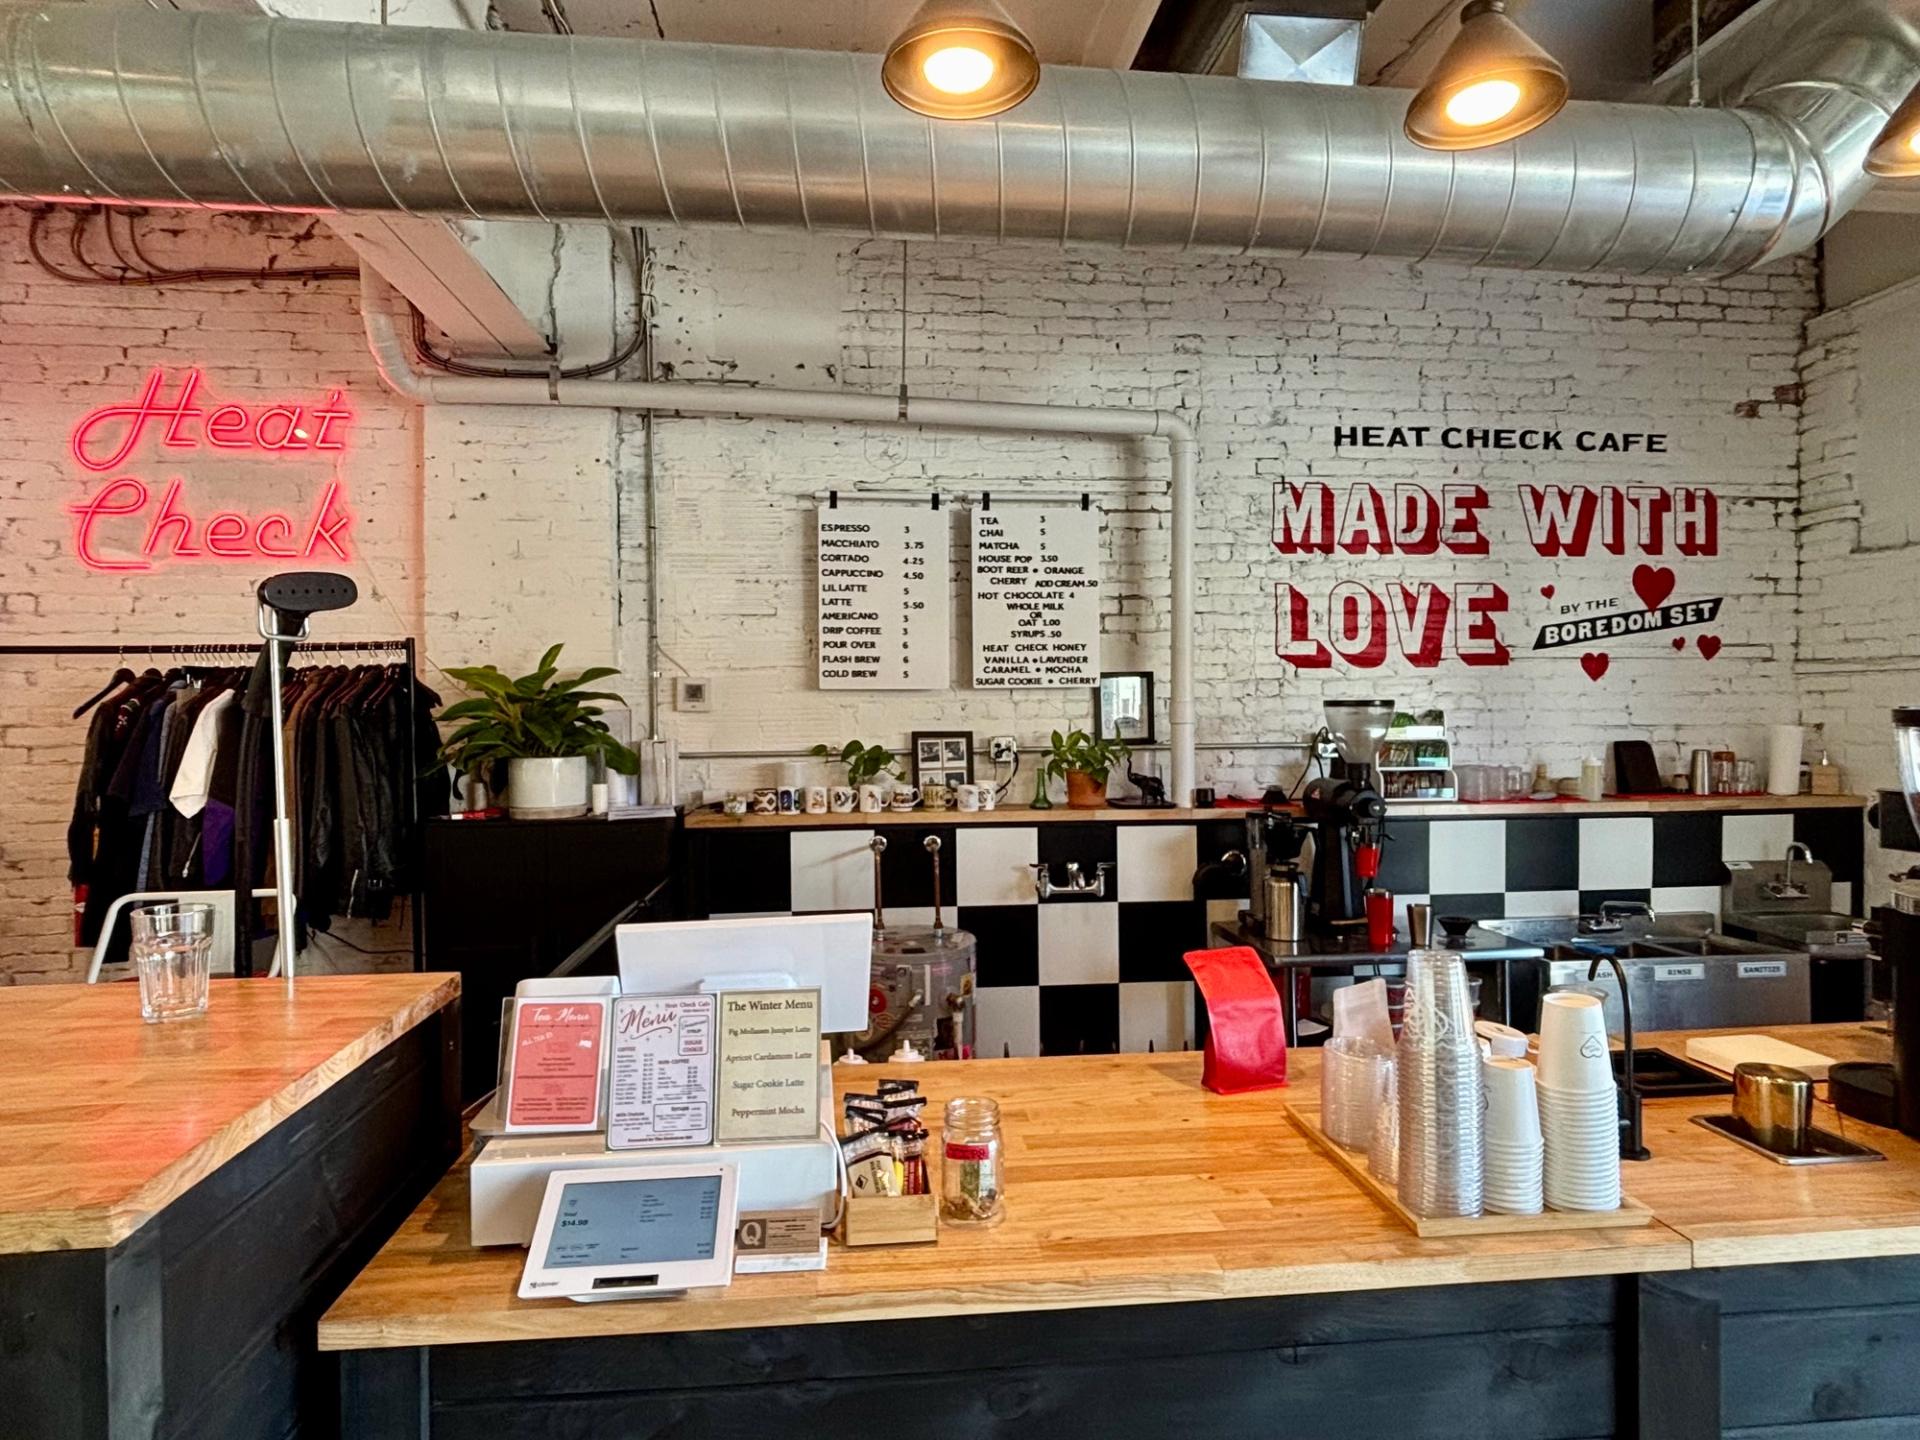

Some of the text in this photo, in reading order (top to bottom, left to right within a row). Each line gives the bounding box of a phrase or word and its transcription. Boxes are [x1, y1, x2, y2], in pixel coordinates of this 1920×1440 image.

[73, 370, 351, 471] Heat
[1334, 427, 1668, 453] HEAT CHECK CAFE
[980, 517, 998, 525] TEA
[1271, 482, 1718, 556] MADE WITH
[71, 479, 348, 569] Check
[821, 524, 870, 532] ESPRESSO
[821, 540, 879, 548] MACCHIATO
[821, 554, 869, 562] CORTADO
[977, 566, 1003, 574] BOOT
[821, 569, 924, 580] CAPPUCCINO 4.50
[839, 584, 867, 592] LATTE
[822, 598, 852, 606] LATTE
[1560, 598, 1619, 614] BY THE
[821, 612, 879, 620] AMERICANO
[1274, 581, 1510, 668] LOVE
[1545, 601, 1715, 645] BOREDOM SET
[1011, 630, 1045, 638] SYRUPS
[823, 641, 847, 649] POUR
[851, 641, 876, 649] OVER
[823, 670, 849, 678] COLD
[851, 670, 877, 678] BREW
[983, 666, 1030, 674] CARAMEL
[1059, 677, 1097, 685] CHERRY
[727, 1000, 813, 1011] The Winter Menu
[619, 1005, 677, 1034] Menu
[741, 1222, 761, 1246] Q
